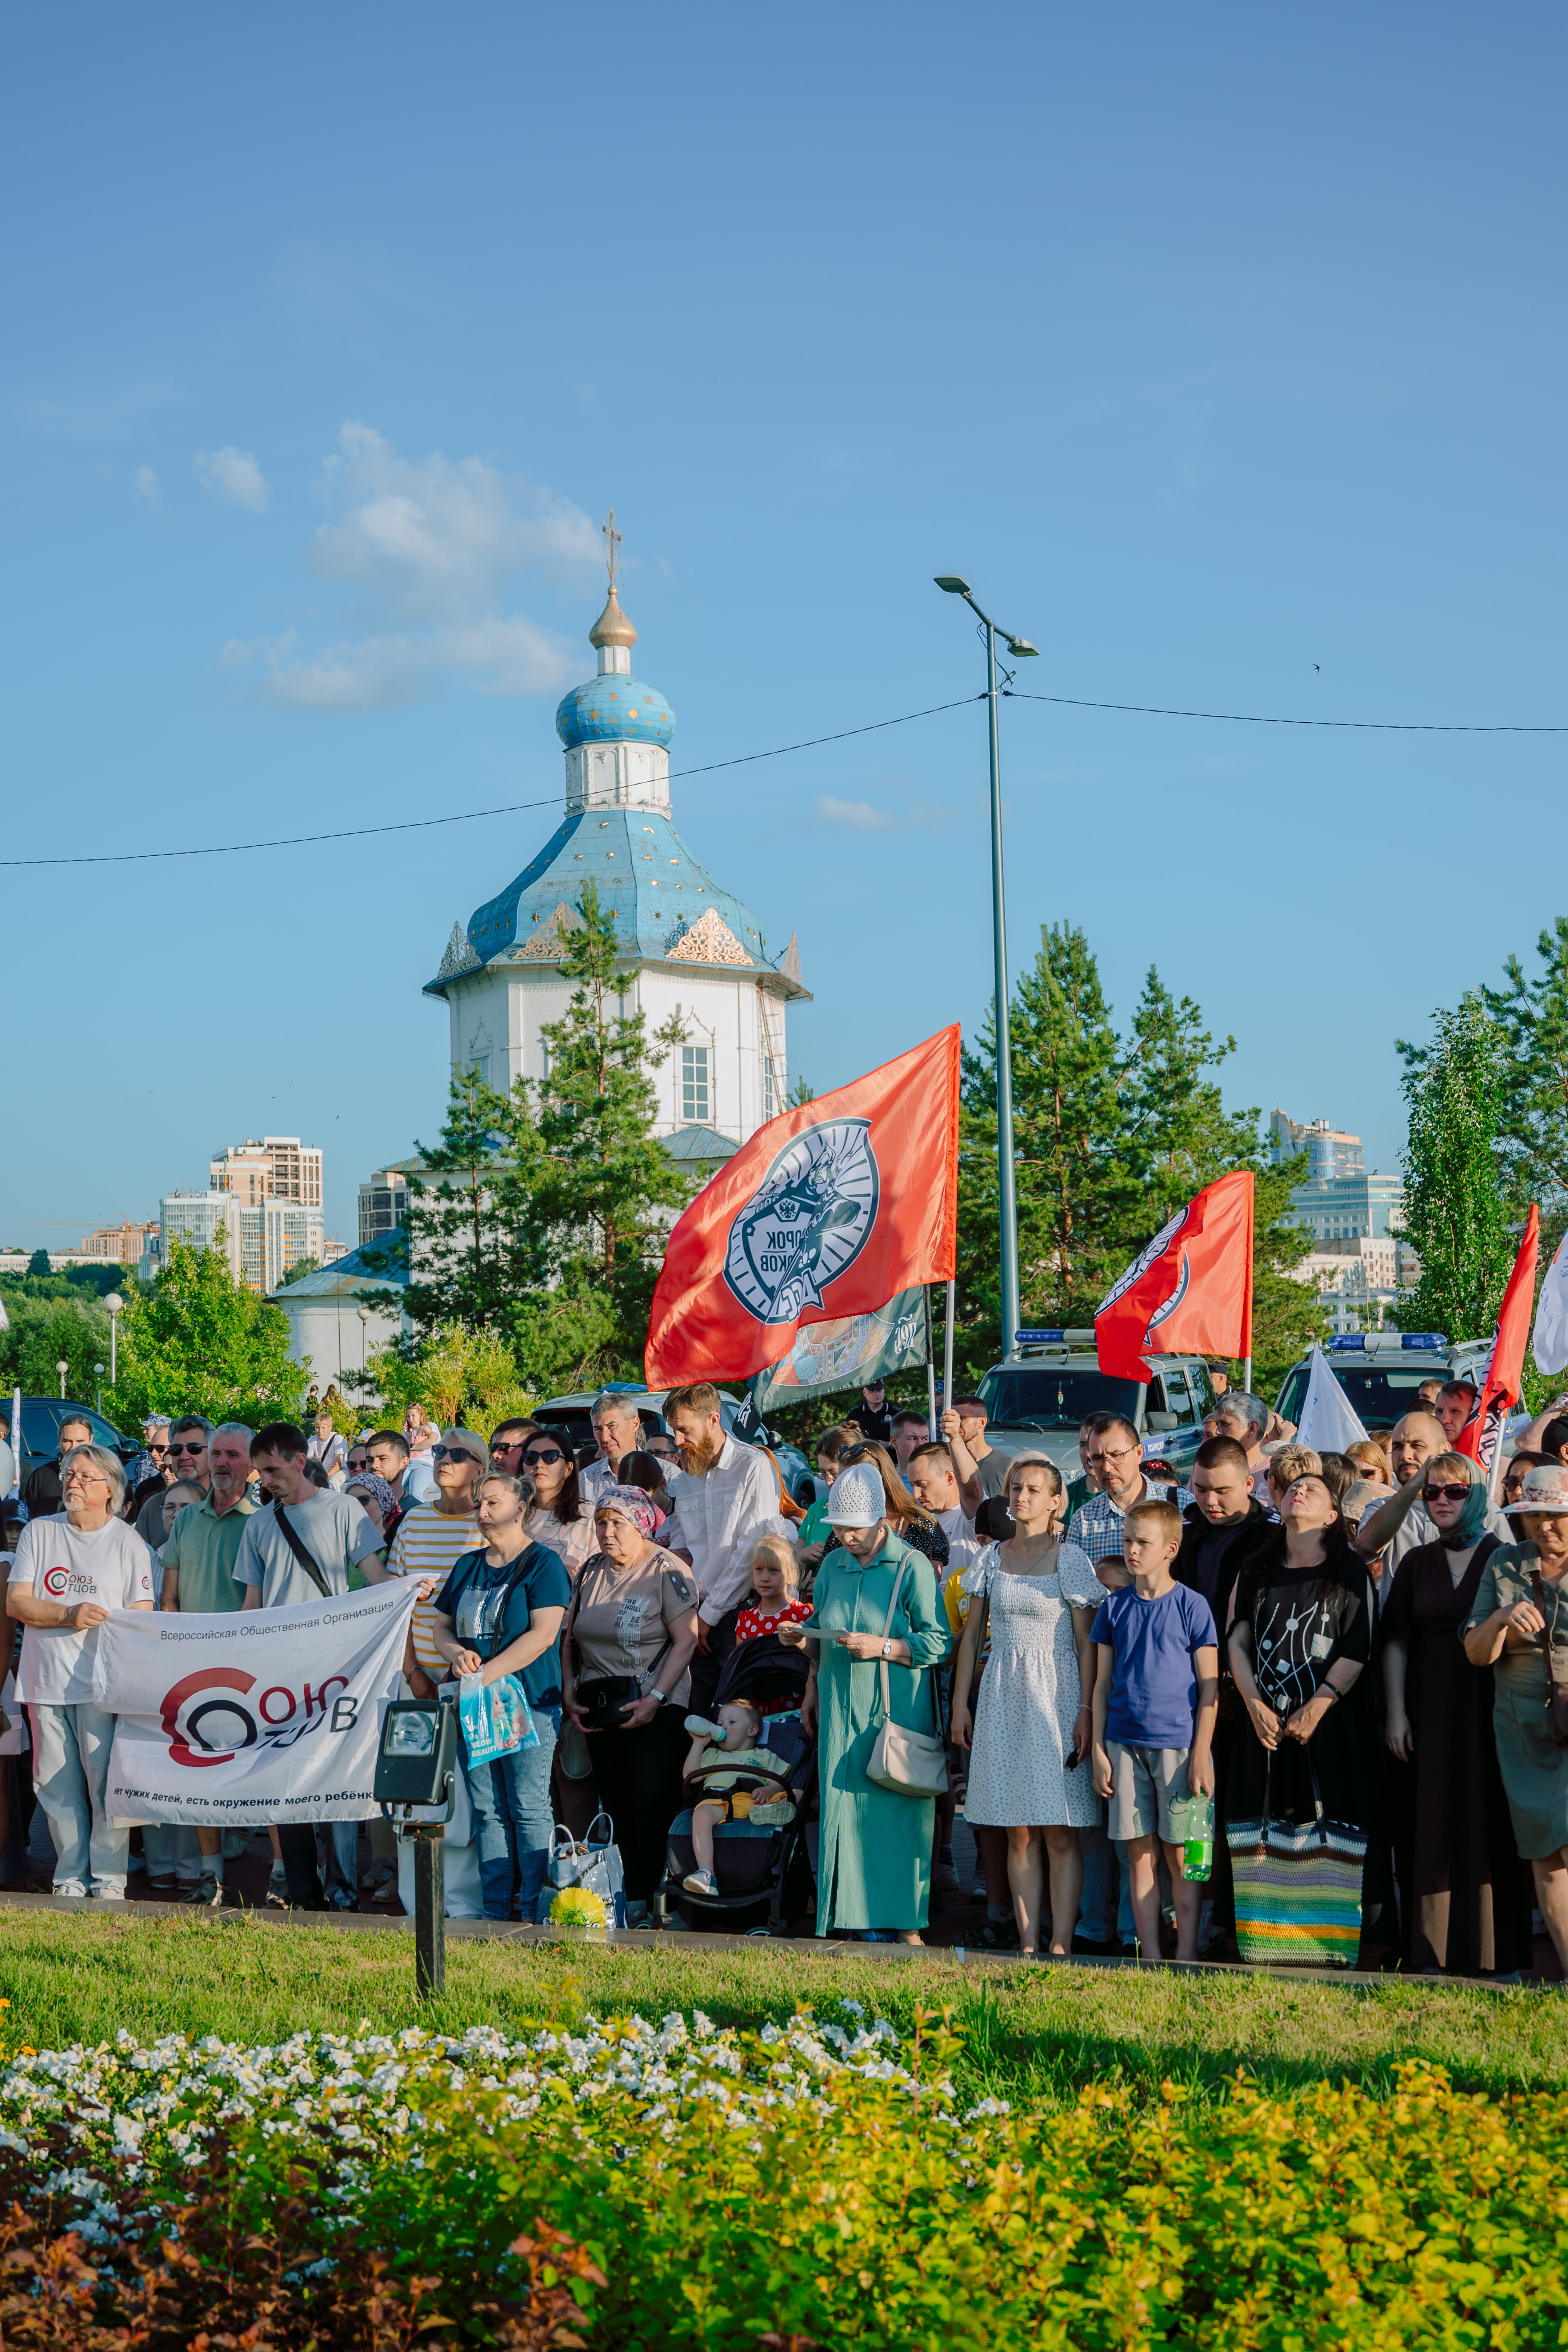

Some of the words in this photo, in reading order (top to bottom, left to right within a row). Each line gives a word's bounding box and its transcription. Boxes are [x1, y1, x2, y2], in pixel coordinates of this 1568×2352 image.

[1147, 1441, 1164, 1453] ПОЛИЦИЯ
[161, 1630, 237, 1642] Всероссийская
[240, 1619, 319, 1636] Общественная
[323, 1601, 394, 1625] Организация
[470, 1738, 492, 1748] MEOW
[471, 1745, 497, 1757] BEAUTY
[125, 1789, 150, 1799] чужих
[151, 1793, 183, 1805] детей,
[213, 1799, 280, 1809] окружение
[285, 1795, 321, 1805] моего
[325, 1791, 373, 1803] ребёнк
